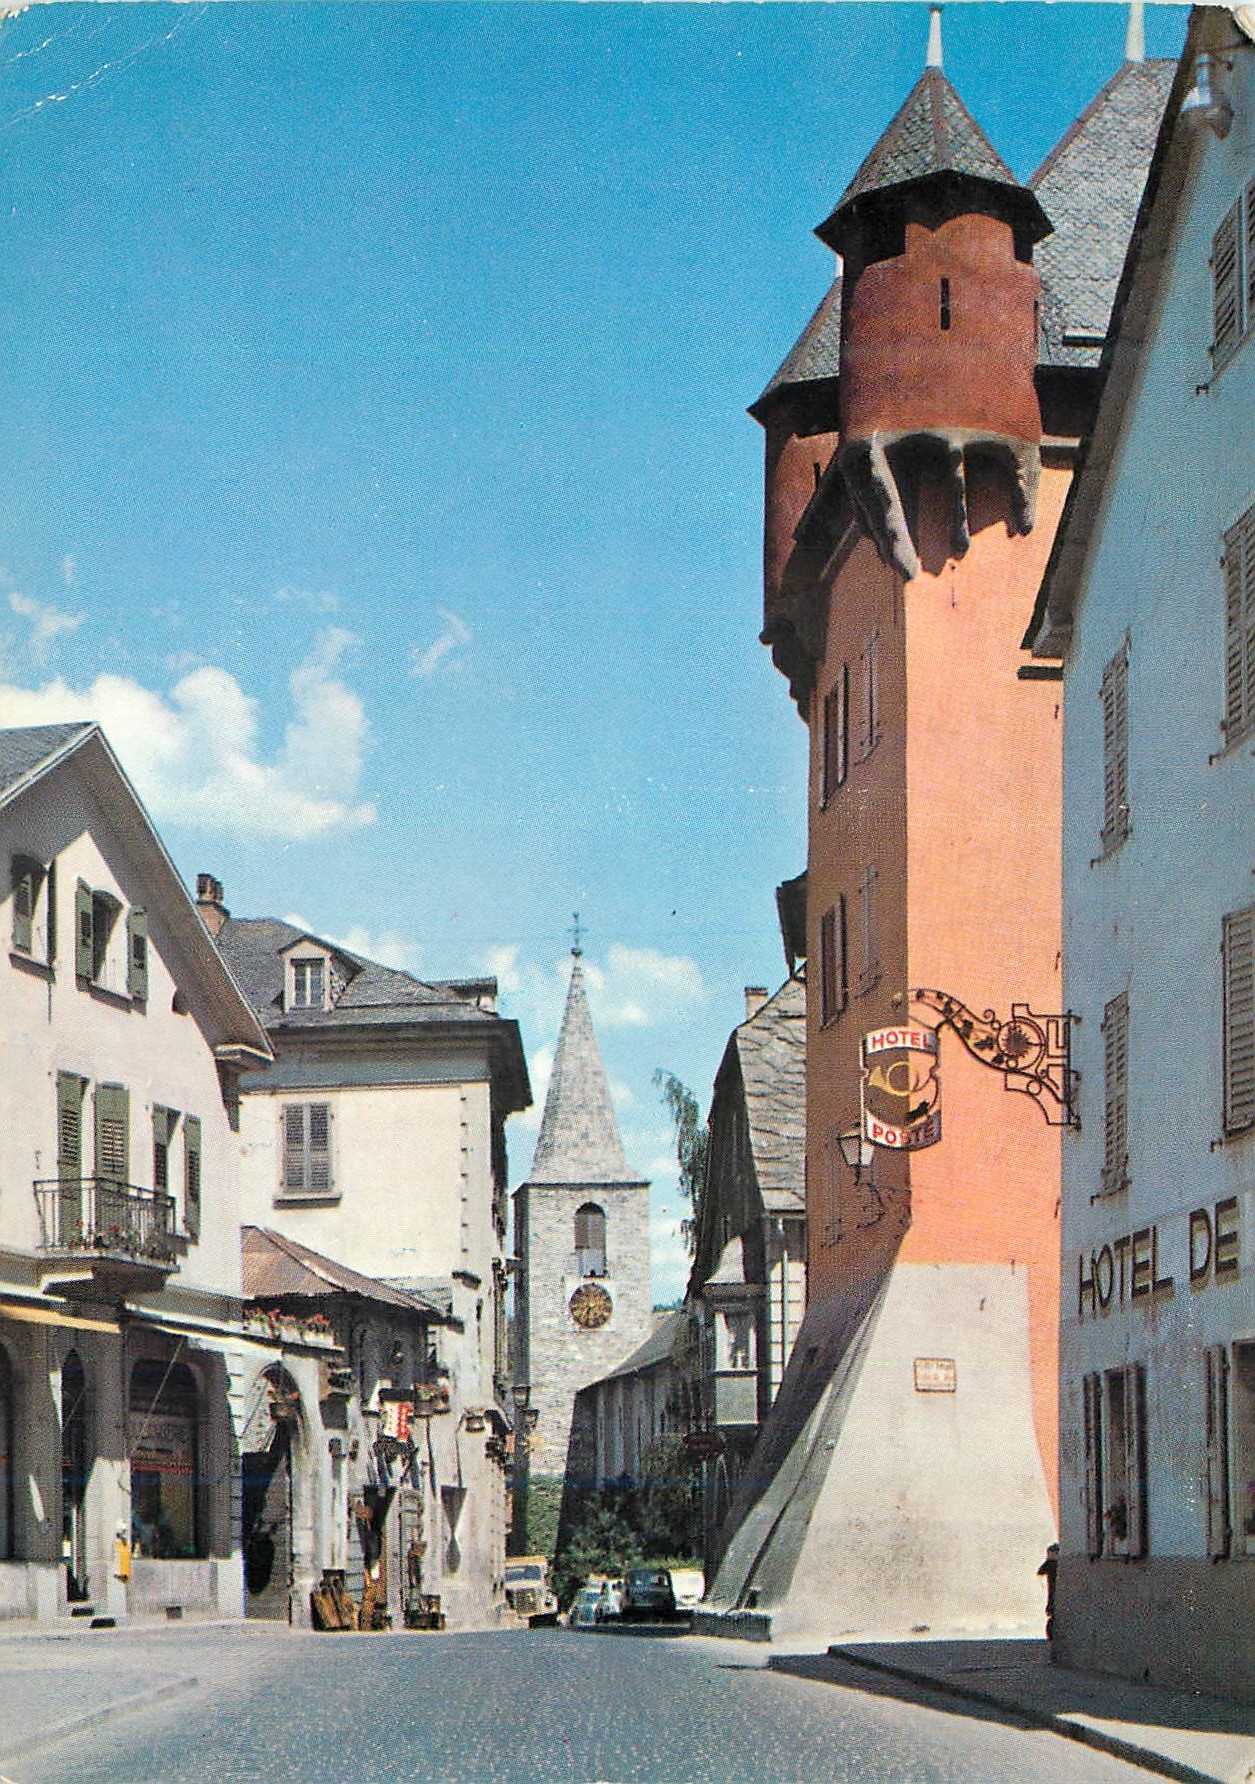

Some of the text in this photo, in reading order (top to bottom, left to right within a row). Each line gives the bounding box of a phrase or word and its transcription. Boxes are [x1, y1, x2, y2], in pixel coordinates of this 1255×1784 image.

[872, 1031, 933, 1049] HOTEL
[1079, 1195, 1239, 1319] HOTEL DE
